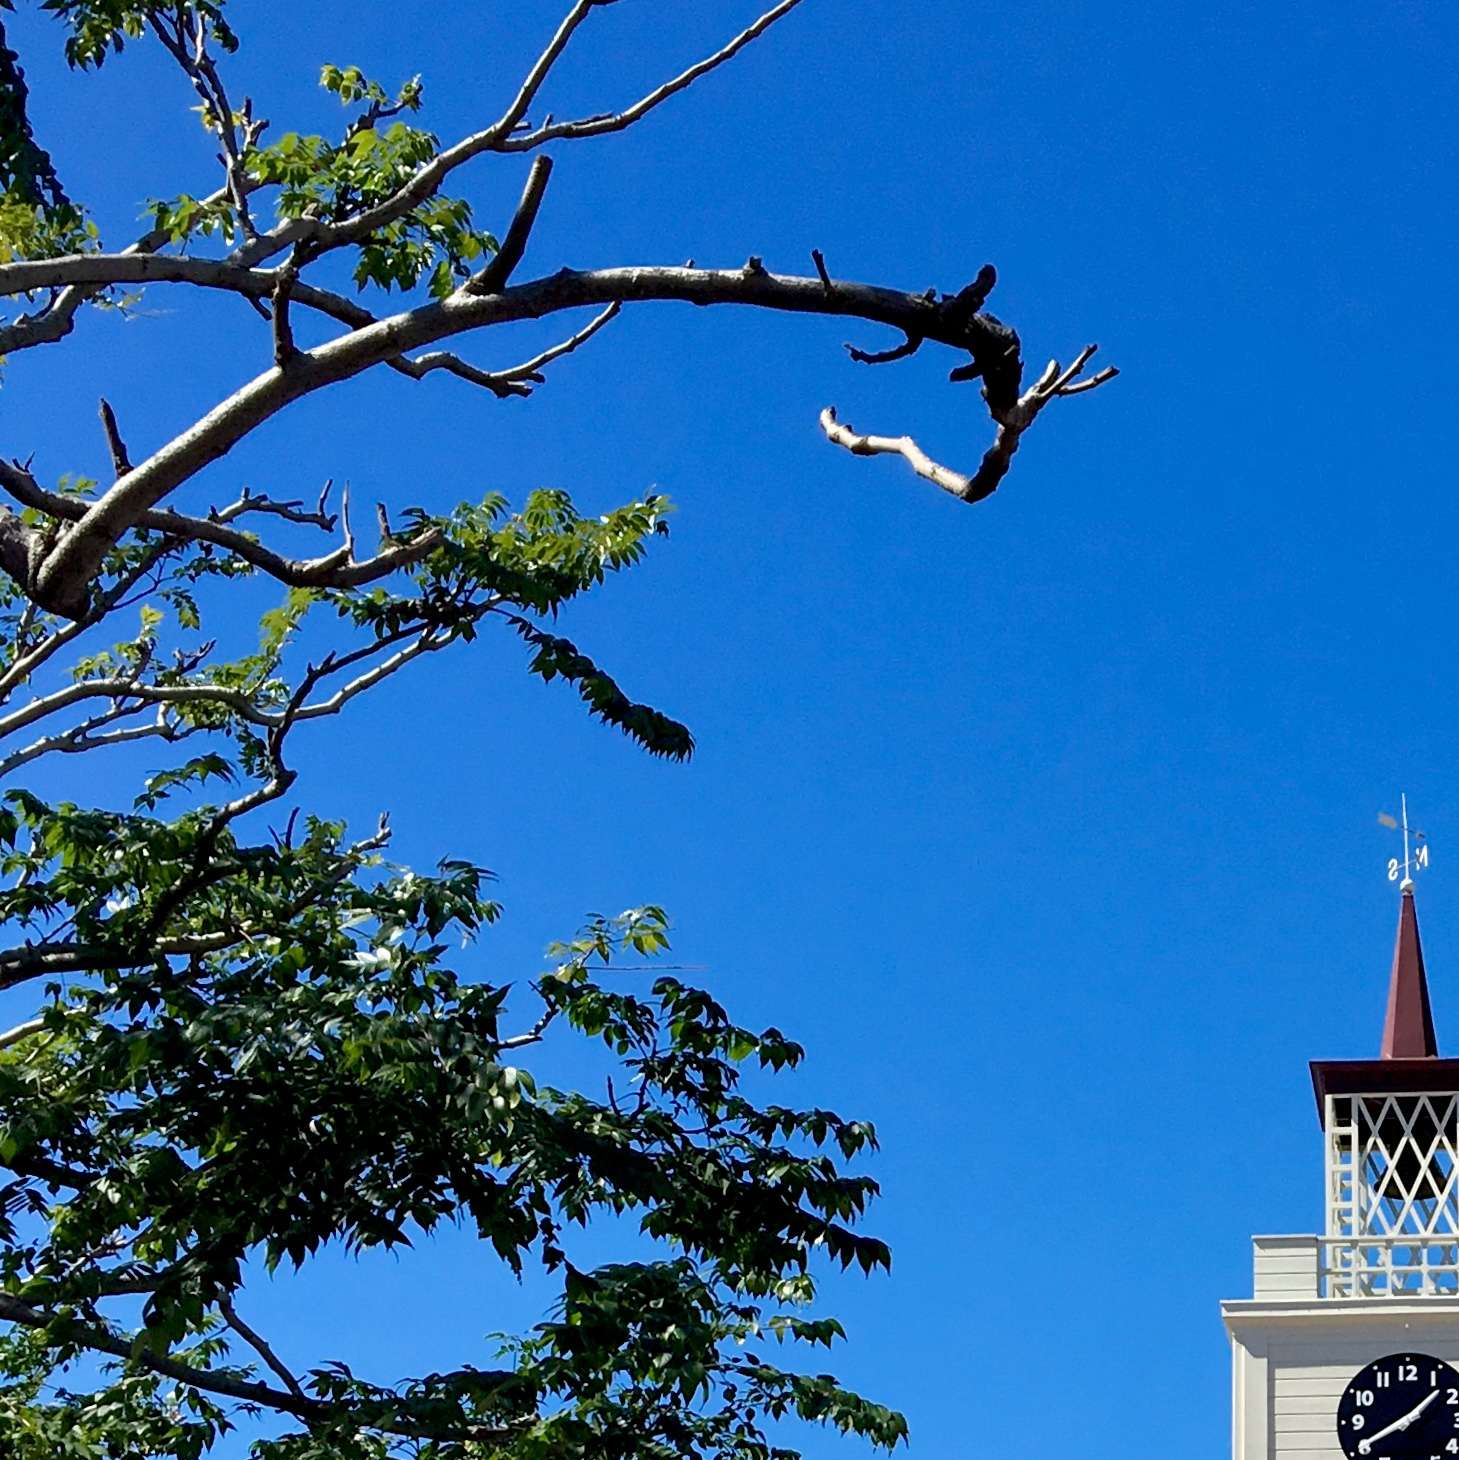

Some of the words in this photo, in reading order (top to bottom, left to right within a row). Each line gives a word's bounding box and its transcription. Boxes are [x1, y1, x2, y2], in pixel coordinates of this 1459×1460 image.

[1377, 1371, 1389, 1388] 11
[1398, 1365, 1418, 1381] 12
[1430, 1370, 1436, 1387] 1
[1355, 1390, 1374, 1407] 10
[1446, 1388, 1459, 1405] 2
[1351, 1414, 1365, 1431] 9
[1445, 1438, 1459, 1454] 4
